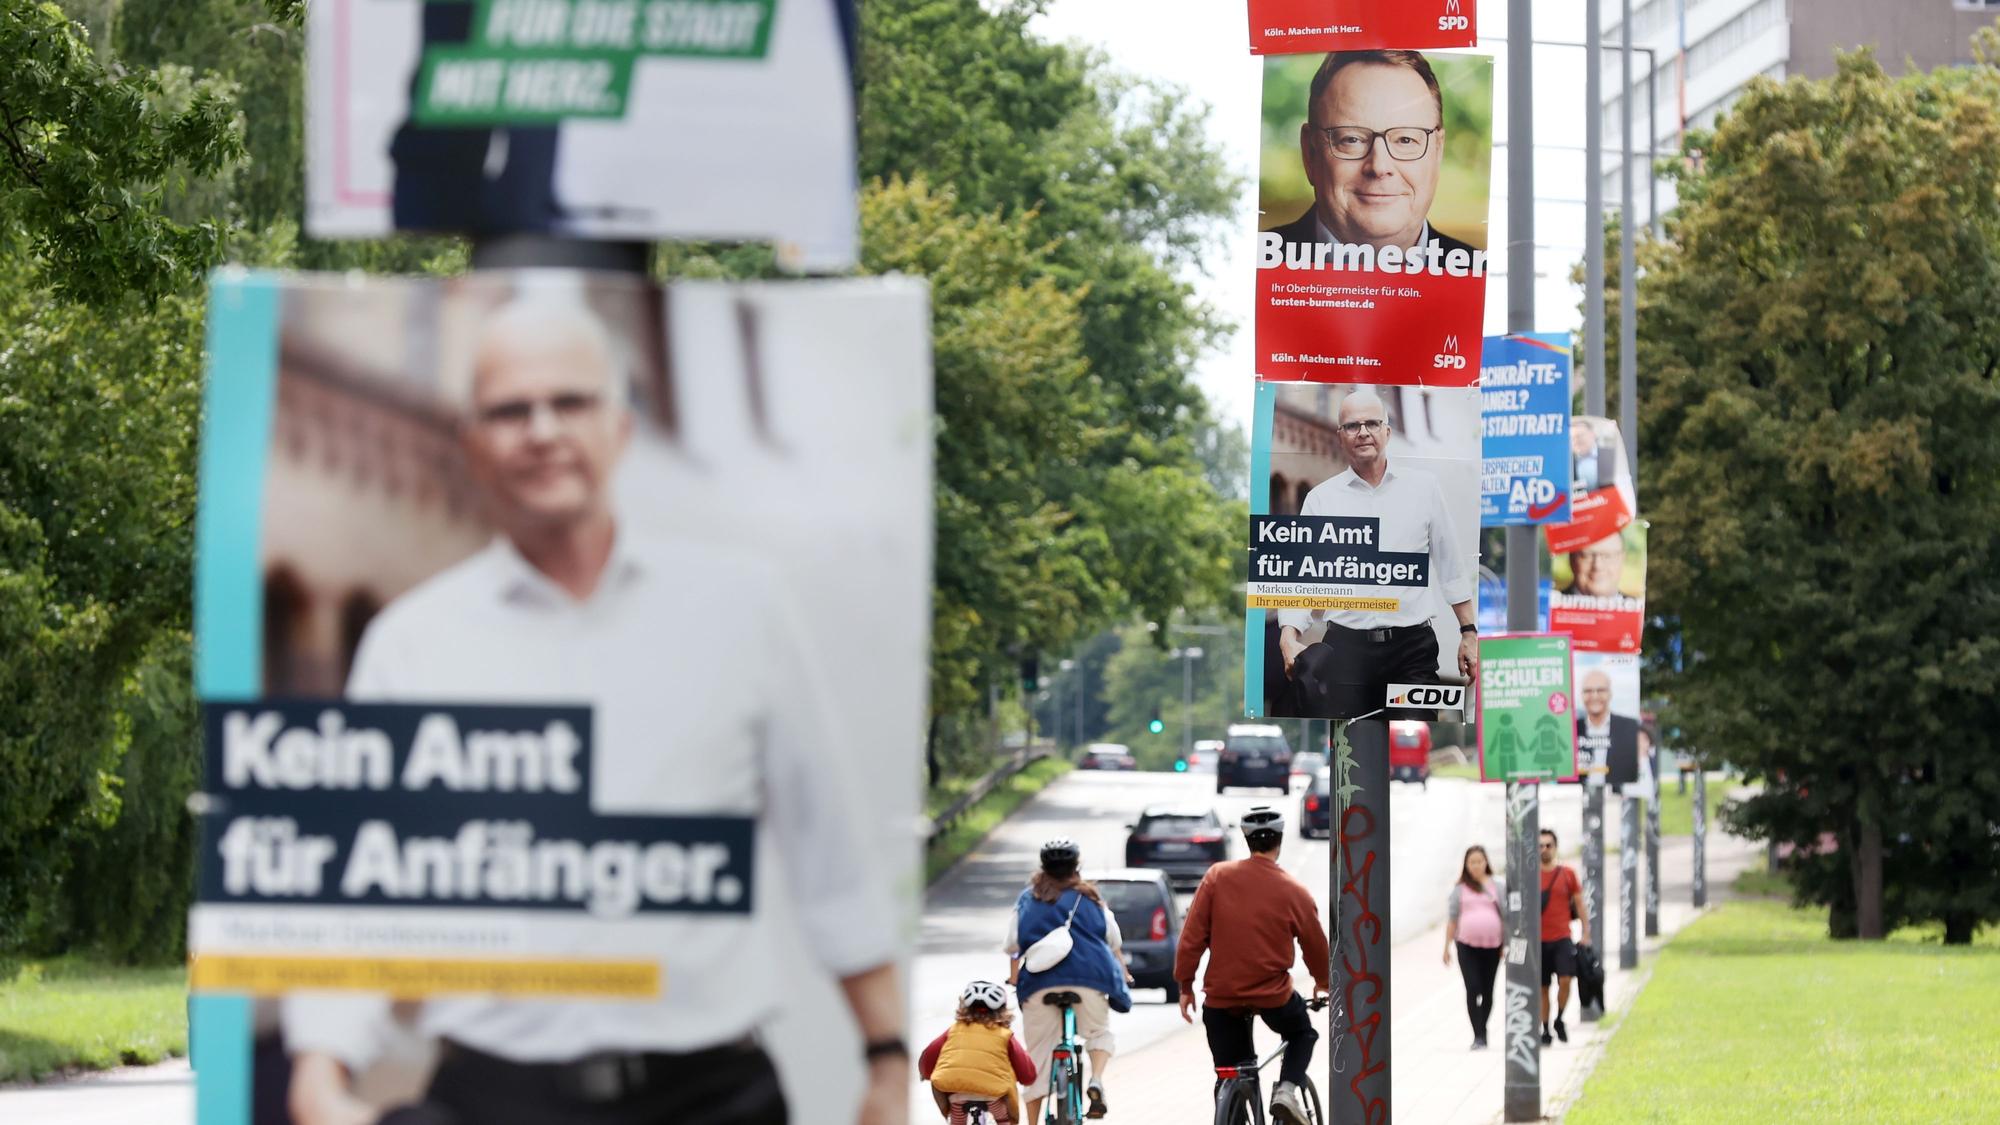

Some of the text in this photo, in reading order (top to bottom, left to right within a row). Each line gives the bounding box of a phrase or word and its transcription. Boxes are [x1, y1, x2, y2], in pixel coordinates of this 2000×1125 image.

[1264, 25, 1363, 37] Köln. Machen mit Herz.
[1438, 15, 1469, 31] SPD
[1256, 231, 1488, 278] Burmester
[1271, 283, 1422, 298] Ihr Oberbürgermeister für Köln.
[1271, 297, 1375, 309] torsten-burmester.de
[1271, 353, 1381, 366] Köln. Machen mit Herz.
[1433, 354, 1466, 369] SPD
[1481, 359, 1563, 387] ACHKRÄFTE-
[1481, 389, 1530, 412] ANGEL?
[1488, 413, 1564, 437] STADTRAT!
[1481, 457, 1541, 476] ERSPRECHEN
[1508, 477, 1556, 505] AfD
[1258, 520, 1373, 545] Kein Amt
[1257, 554, 1423, 585] für Anfänger.
[1256, 584, 1353, 596] Markus Greitemann
[1256, 597, 1397, 611] Ihr neuer Oberbürgermeister
[1483, 667, 1563, 689] SCHULEN
[1406, 688, 1462, 706] CDU
[222, 708, 583, 793] Kein Amt
[218, 815, 744, 918] für Anfänger.
